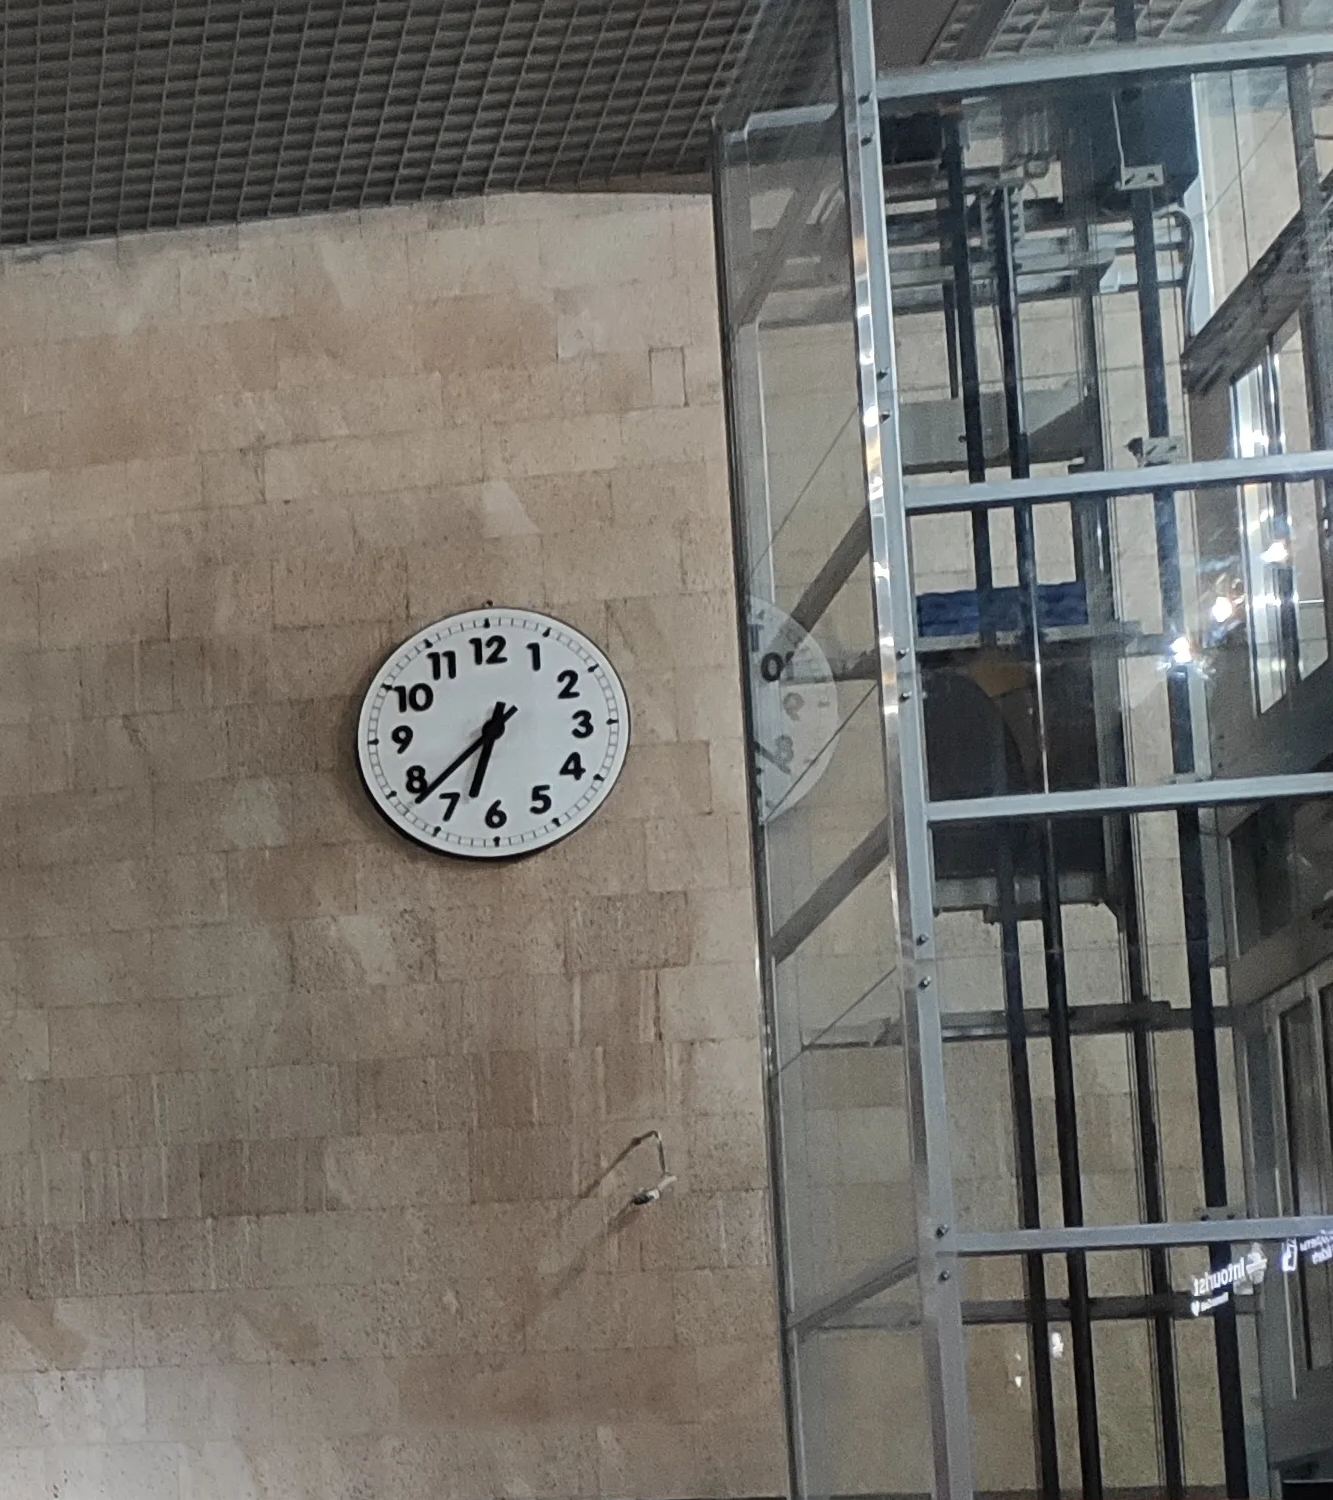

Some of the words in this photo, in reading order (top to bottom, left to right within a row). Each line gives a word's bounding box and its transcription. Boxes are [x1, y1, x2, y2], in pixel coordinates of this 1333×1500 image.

[469, 636, 507, 664] 12
[527, 643, 541, 670] 1
[427, 650, 457, 679] 11
[394, 683, 433, 712] 10
[557, 670, 580, 699] 2
[572, 710, 593, 738] 3
[392, 726, 413, 754] 9
[405, 766, 427, 794] 8
[560, 752, 586, 781] 4
[439, 793, 460, 821] 7
[530, 785, 552, 814] 5
[485, 800, 507, 828] 6
